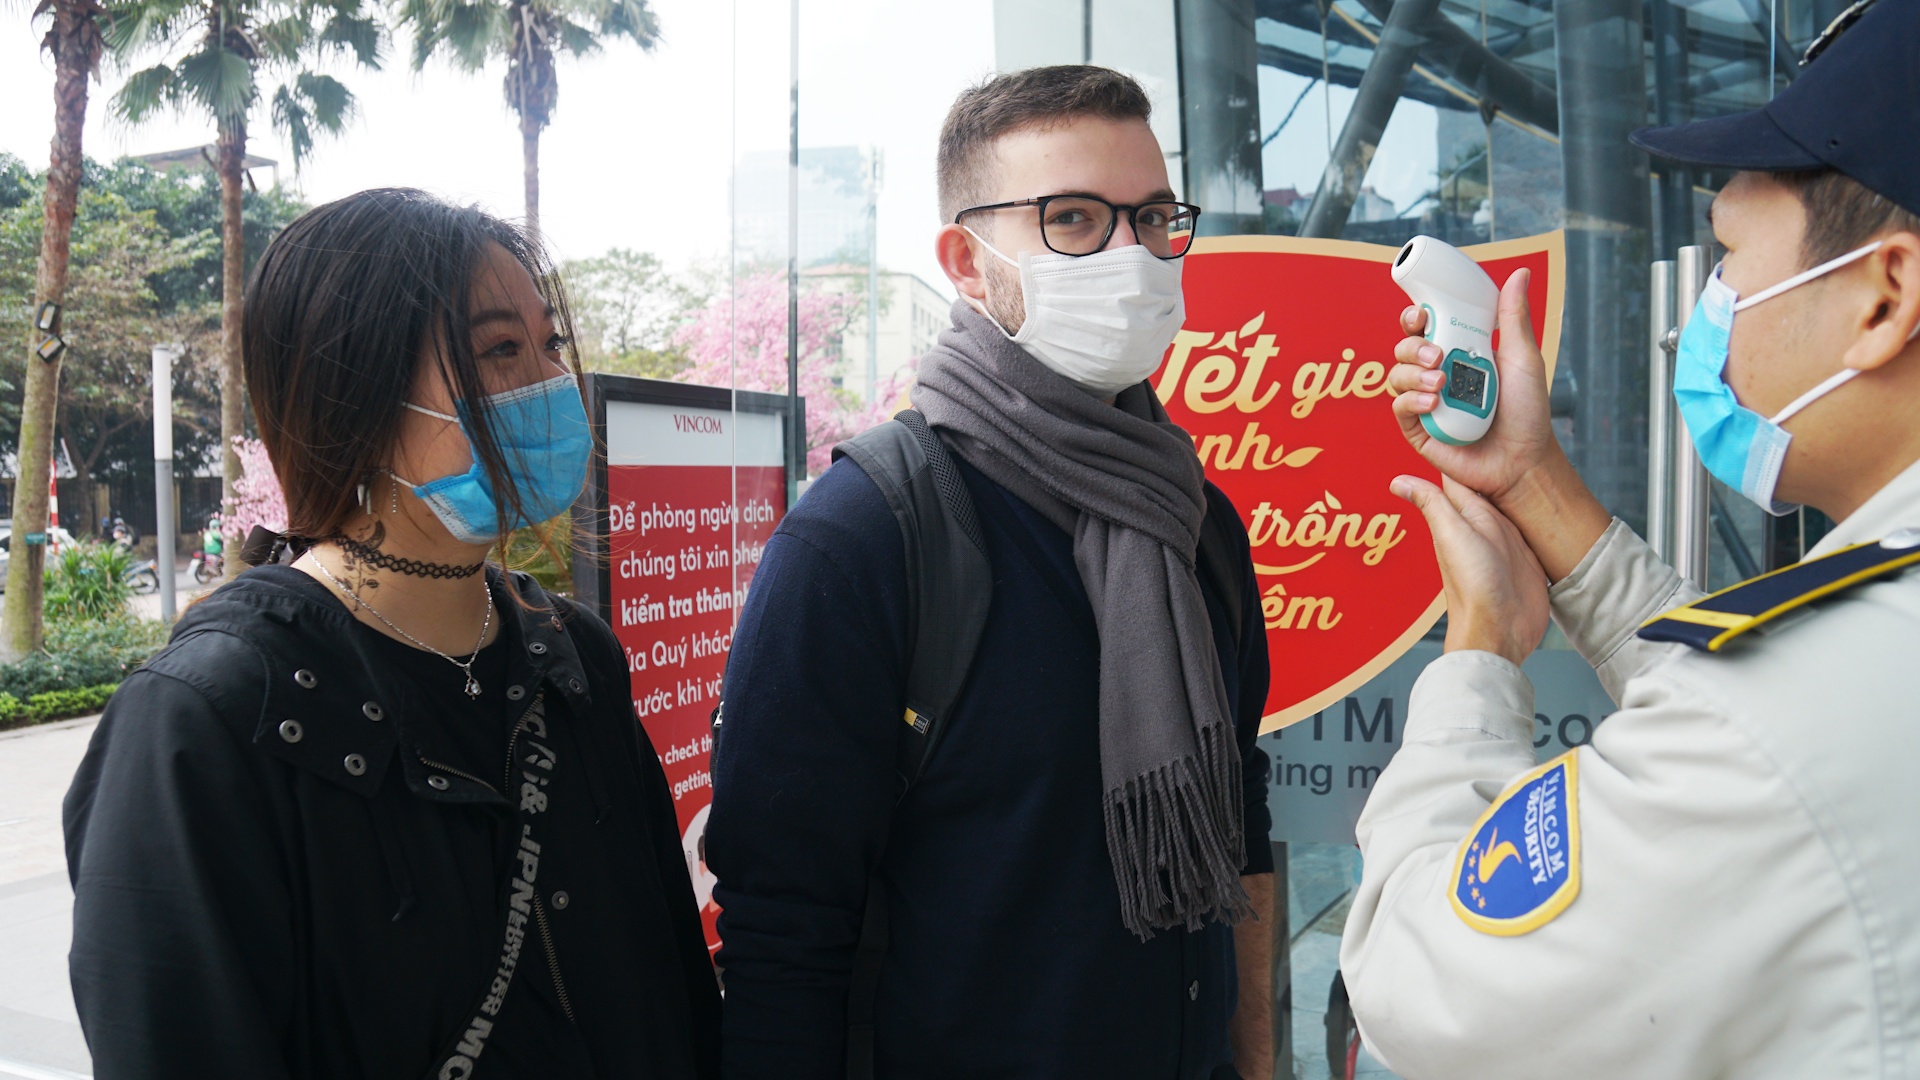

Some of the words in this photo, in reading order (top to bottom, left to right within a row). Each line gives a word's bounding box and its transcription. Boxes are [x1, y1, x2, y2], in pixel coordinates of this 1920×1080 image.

[1154, 311, 1281, 414] Tết
[673, 414, 723, 434] VINCOM
[609, 501, 636, 531] Để
[641, 503, 695, 536] phòng
[743, 498, 774, 529] dịch
[1250, 490, 1406, 566] trồng
[620, 549, 675, 580] chúng
[680, 546, 701, 572] tôi
[706, 544, 728, 568] xin
[621, 594, 665, 627] kiểm
[668, 595, 693, 619] tra
[696, 587, 732, 614] thân
[652, 636, 687, 668] Quý
[677, 677, 702, 707] khi
[665, 738, 699, 765] check
[1544, 771, 1566, 873] VINCOM
